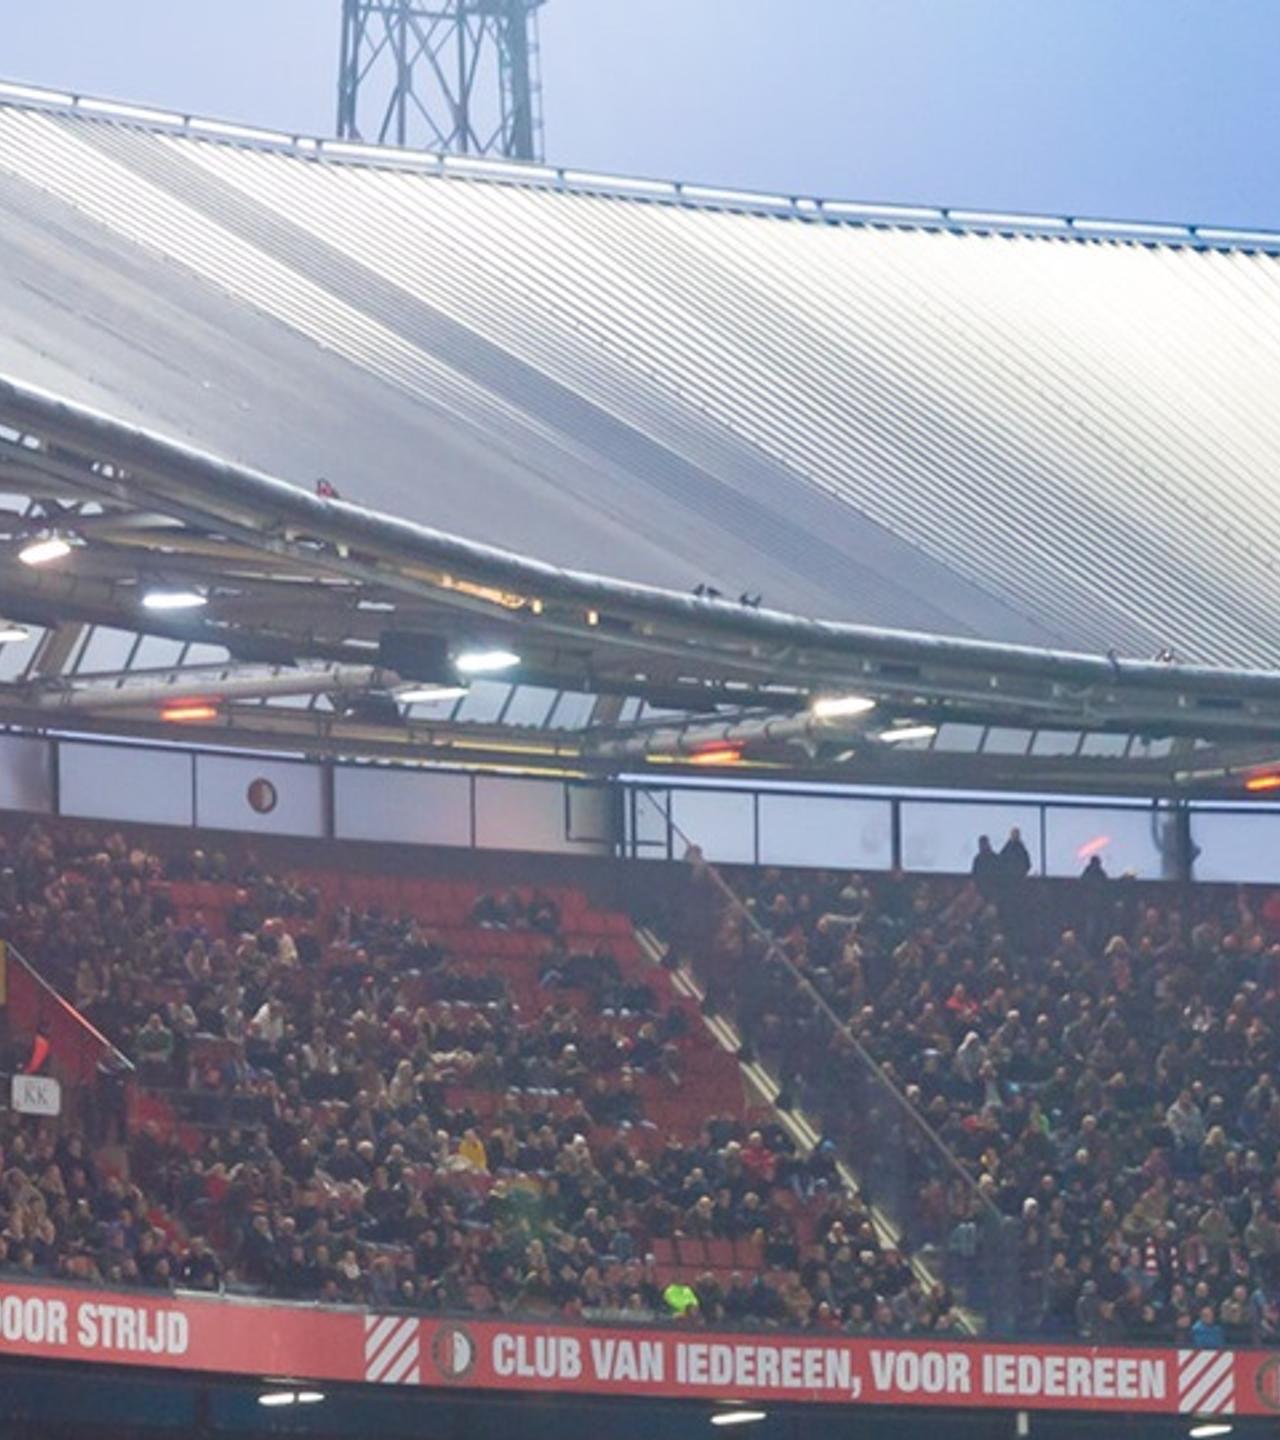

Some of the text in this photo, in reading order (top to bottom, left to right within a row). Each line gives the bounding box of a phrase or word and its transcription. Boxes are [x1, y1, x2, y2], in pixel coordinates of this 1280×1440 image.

[24, 1083, 50, 1106] KK
[76, 1302, 189, 1354] STRIJD
[491, 1333, 1166, 1399] CLUB VAN IEDEREEN, VOOR IEDEREEN
